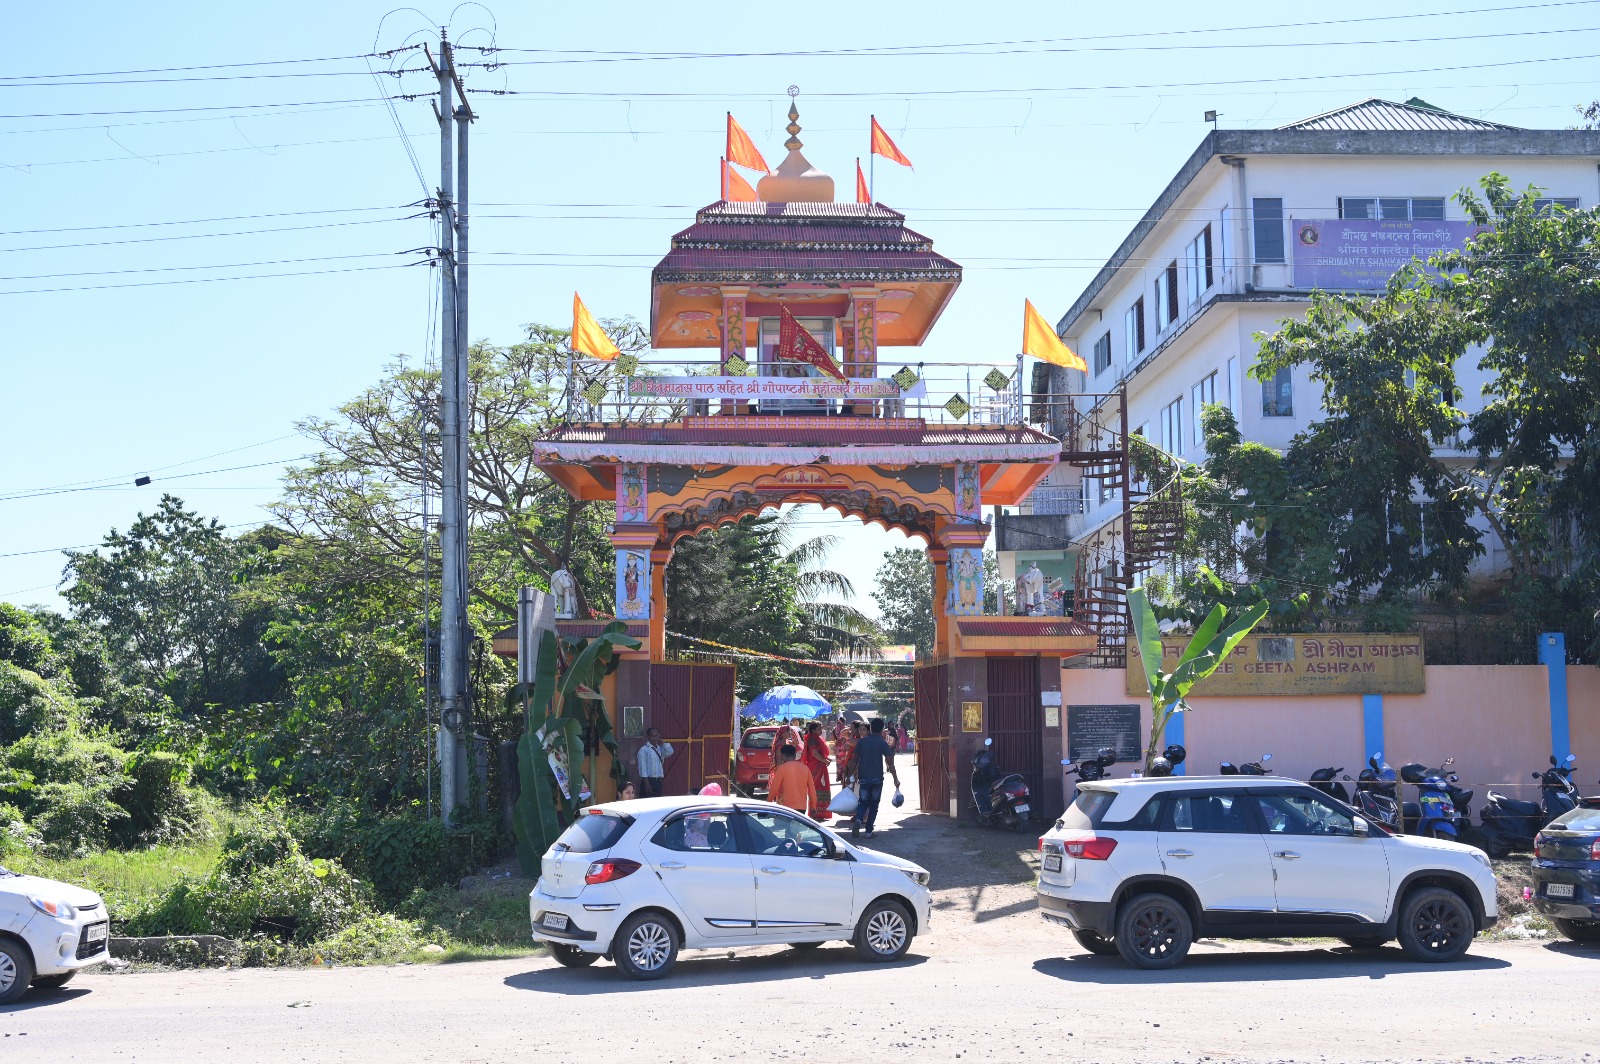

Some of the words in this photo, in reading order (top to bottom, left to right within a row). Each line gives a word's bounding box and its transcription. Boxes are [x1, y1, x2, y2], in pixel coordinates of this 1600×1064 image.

[1317, 257, 1365, 267] SHRIMANTA
[695, 383, 715, 394] पाठ
[716, 381, 744, 395] सहित
[746, 381, 761, 394] श्री
[762, 381, 809, 394] गोपाष्टमी
[852, 381, 875, 394] मेला
[1243, 662, 1294, 674] GEETA
[1305, 662, 1377, 674] ASHRAM
